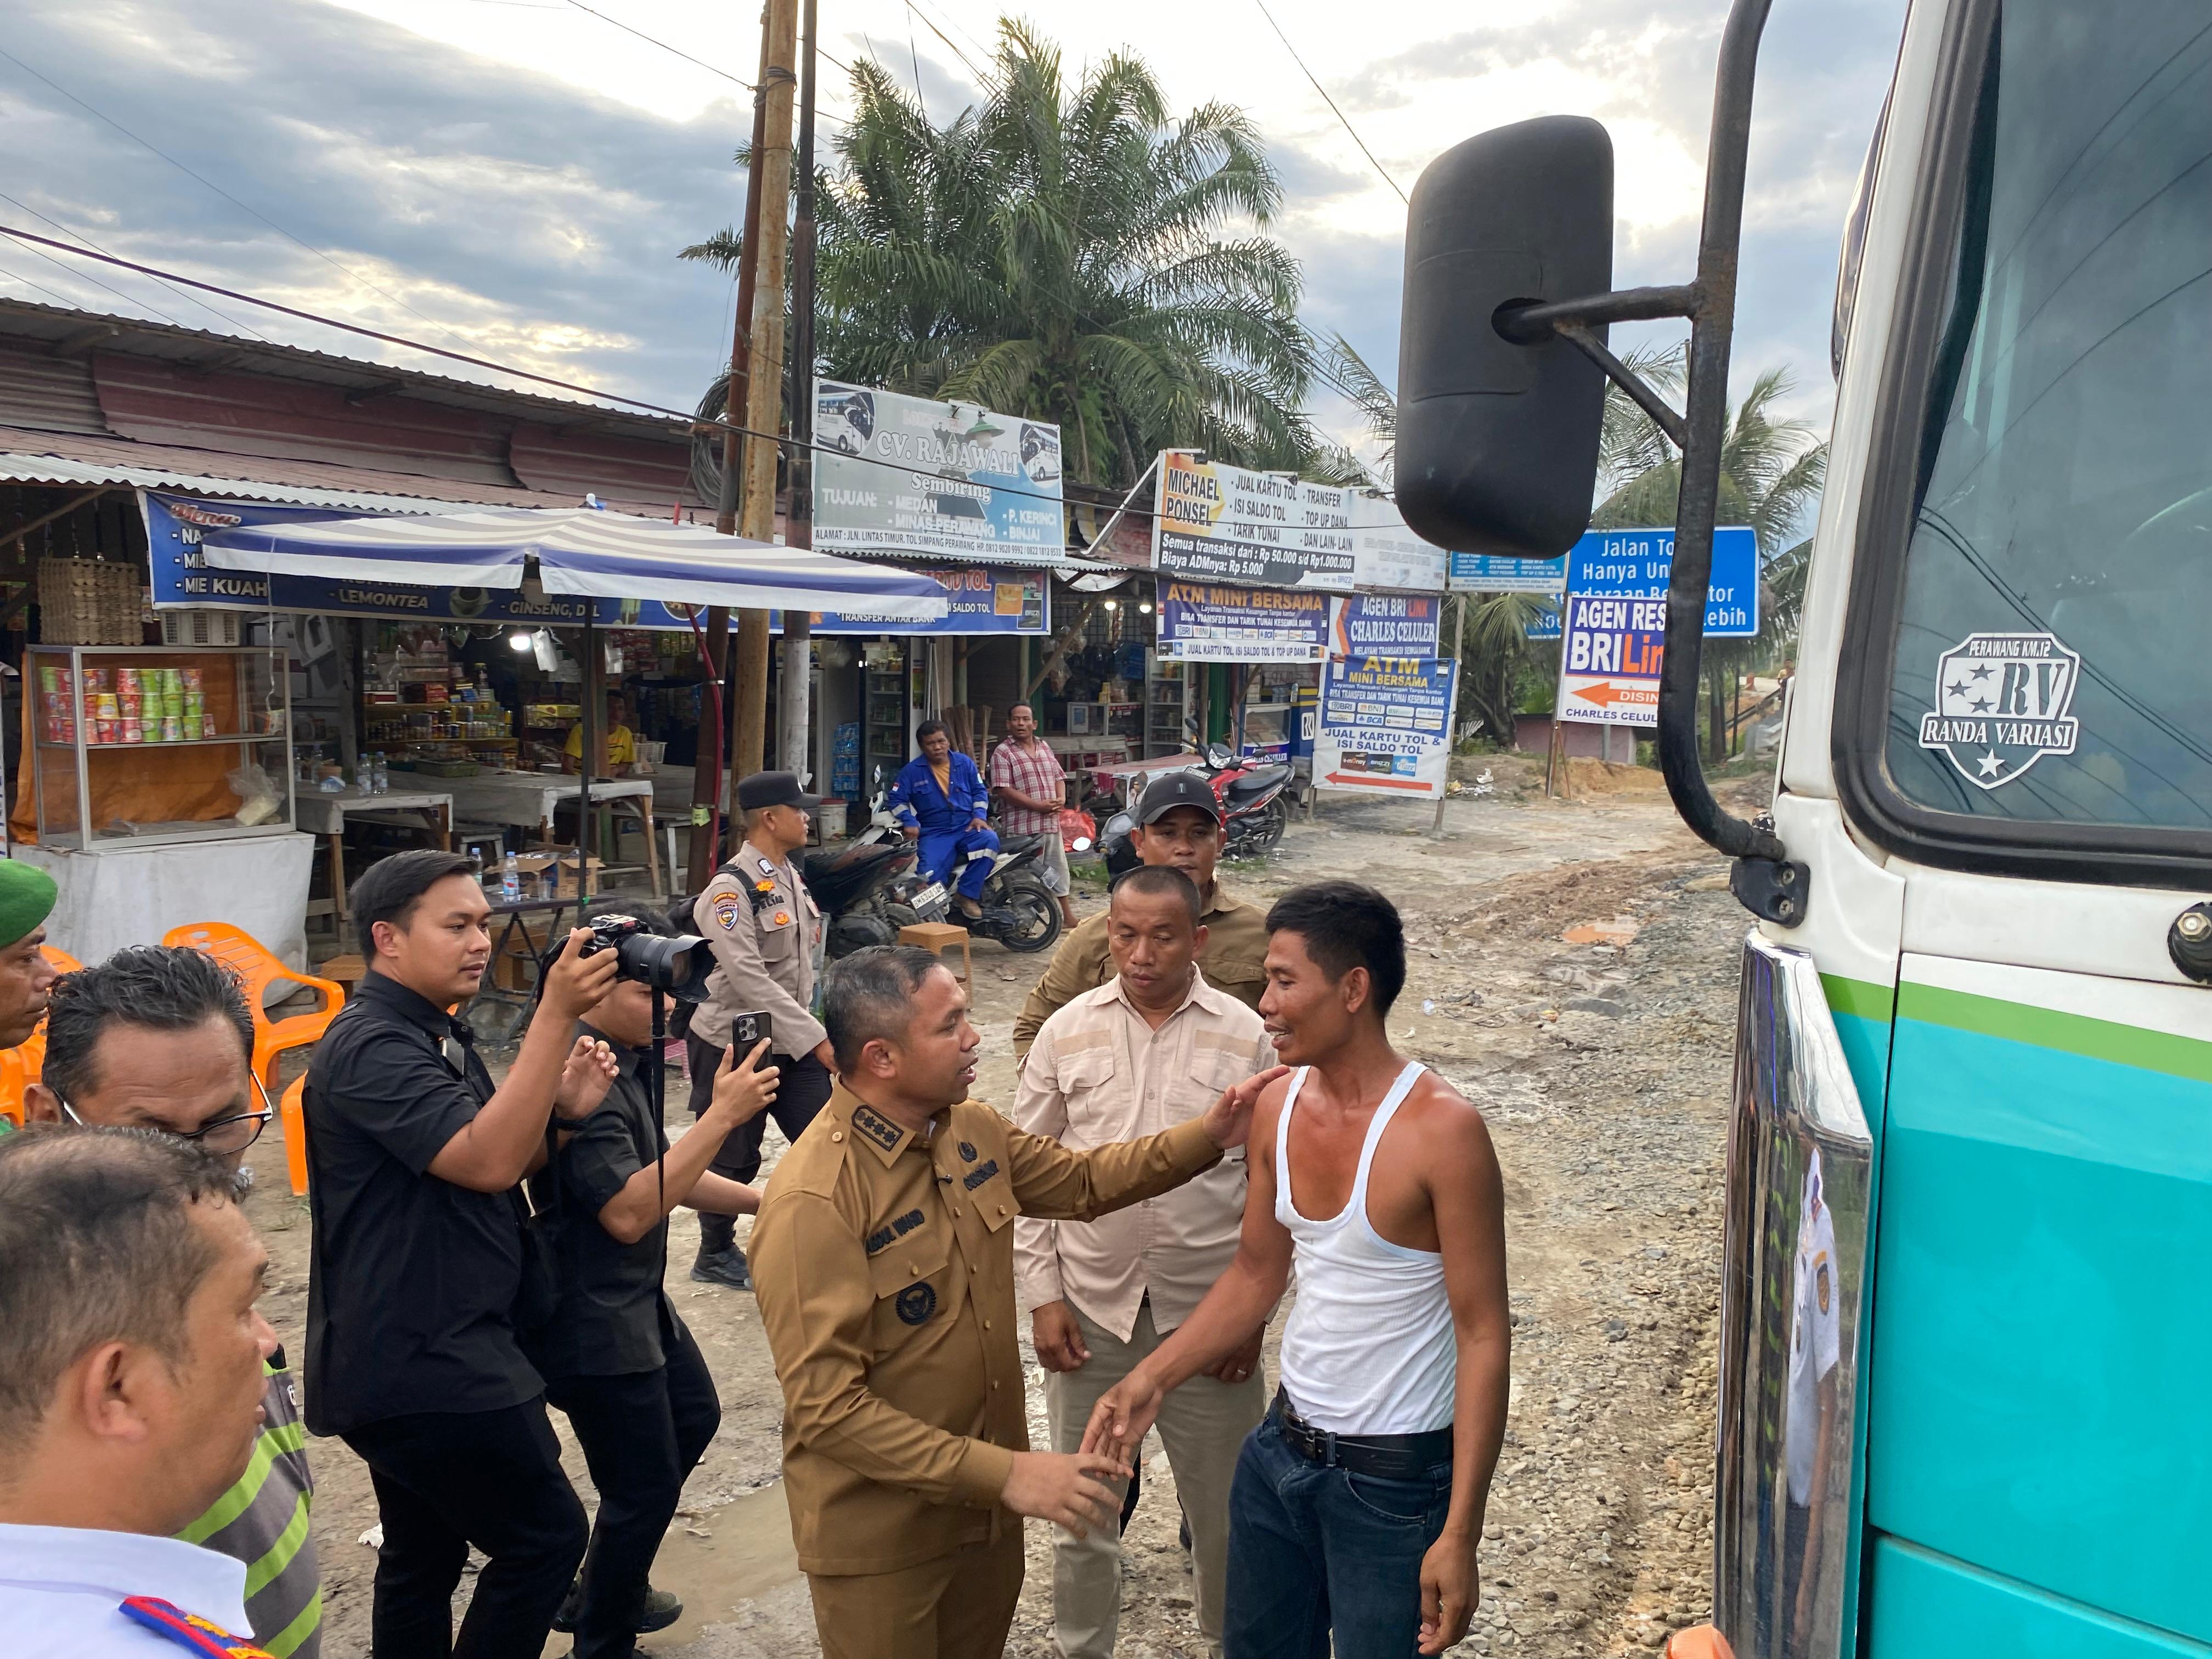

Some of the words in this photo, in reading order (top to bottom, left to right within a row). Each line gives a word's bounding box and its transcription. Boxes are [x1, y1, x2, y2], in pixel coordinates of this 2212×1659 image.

[876, 430, 912, 460] CV.
[916, 437, 1019, 476] RAJAWALI
[911, 472, 991, 504] Sembiring
[1169, 469, 1220, 501] MICHAEL
[1235, 475, 1255, 493] JUAL
[1257, 478, 1282, 499] KARTU
[1284, 484, 1297, 501] TOL
[822, 488, 878, 507] TUJUAN:
[895, 495, 938, 514] MEDAN
[1307, 489, 1341, 508] TRANSFER
[1008, 509, 1018, 523] P.
[1166, 496, 1212, 527] PONSEL
[1234, 498, 1244, 514] ISI
[1246, 500, 1271, 518] SALDO
[1273, 505, 1286, 521] TOL
[1306, 511, 1319, 526] TOP
[1321, 514, 1329, 527] UP
[1331, 515, 1348, 528] DANA
[182, 528, 202, 544] NA
[815, 529, 842, 540] ALAMAT
[847, 531, 860, 540] JLN.
[862, 531, 883, 542] LINTAS
[906, 534, 917, 545] TOL
[918, 535, 944, 548] SIMPANG
[945, 539, 975, 551] PERAWANG
[977, 543, 985, 552] HP.
[986, 544, 998, 553] 0812
[1009, 526, 1040, 541] BINJAI
[1233, 522, 1255, 540] TARIK
[1258, 526, 1280, 543] TUNAI
[1162, 533, 1194, 551] Semua
[1197, 539, 1237, 557] transaksi
[1237, 545, 1253, 560] dari
[1259, 548, 1270, 564] Rp
[1272, 549, 1297, 564] 50.000
[1298, 553, 1309, 566] s/d
[1310, 554, 1352, 569] Rp1.000.000
[1304, 533, 1317, 548] DAN
[1338, 537, 1353, 552] LAIN
[1601, 538, 1649, 557] Jalan
[1657, 539, 1674, 556] To
[1161, 550, 1187, 569] Biaya
[1189, 554, 1227, 574] ADMnya:
[1229, 560, 1240, 575] Rp
[1242, 561, 1264, 576] 5.000
[964, 569, 992, 592] TOL
[1583, 563, 1637, 584] Hanya
[1646, 562, 1672, 579] Un
[185, 578, 208, 593] MIE
[213, 578, 268, 597] KUAH
[1167, 583, 1205, 603] ATM
[1210, 588, 1247, 606] MINI
[1252, 591, 1323, 611] BERSAMA
[338, 588, 428, 609] LEMONTEA
[1361, 596, 1389, 617] AGEN
[1390, 597, 1407, 617] BRI
[1408, 600, 1429, 618] LINK
[509, 601, 572, 618] GINSENG,
[576, 603, 600, 617] DL
[953, 603, 975, 613] SALDO
[977, 603, 991, 614] TOL
[1575, 601, 1627, 630] AGEN
[1632, 603, 1667, 631] RES
[1703, 607, 1746, 627] ebih
[1181, 612, 1195, 622] BISA
[1197, 613, 1226, 624] TRANSFER
[1227, 616, 1239, 625] DAN
[1240, 617, 1256, 626] TARIK
[1257, 617, 1273, 627] TUNAI
[1274, 618, 1298, 627] KESEMUA
[1351, 620, 1396, 642] CHARLES
[1397, 622, 1436, 643] CELULER
[1188, 644, 1201, 654] JUAL
[1203, 645, 1221, 655] KARTU
[1244, 646, 1260, 657] SALDO
[1262, 647, 1270, 657] TOL
[1277, 647, 1285, 657] TOP
[1286, 647, 1293, 657] UP
[1294, 647, 1306, 657] DANA
[1354, 646, 1378, 655] MELAYANI
[1378, 646, 1403, 655] TRANSAKSI
[1570, 631, 1664, 674] BRILin
[1969, 640, 2020, 657] PERAWANG
[2021, 641, 2051, 658] KM.12
[1362, 656, 1420, 675] ATM
[1348, 672, 1373, 685] MINI
[1376, 674, 1428, 688] BERSAMA
[1996, 663, 2066, 716] RV
[1329, 689, 1341, 698] BISA
[1342, 690, 1366, 699] TRANSFER
[1367, 691, 1377, 701] DAN
[1378, 692, 1391, 702] TARIK
[1392, 693, 1407, 703] TUNAI
[1407, 694, 1430, 705] KESEMUA
[1431, 696, 1446, 706] BANK
[1620, 691, 1658, 702] DISIN
[1368, 704, 1382, 713] BNI
[1566, 708, 1617, 719] CHARLES
[1621, 712, 1657, 722] CELUL
[1325, 728, 1356, 739] JUAL
[1359, 731, 1401, 743] KARTU
[1404, 735, 1427, 745] TOL
[1432, 737, 1441, 746] &
[1924, 720, 1988, 744] RANDA
[1995, 723, 2072, 747] VARIASI
[1337, 740, 1352, 749] ISI
[1357, 741, 1396, 752] SALDO
[1400, 744, 1423, 755] TOL
